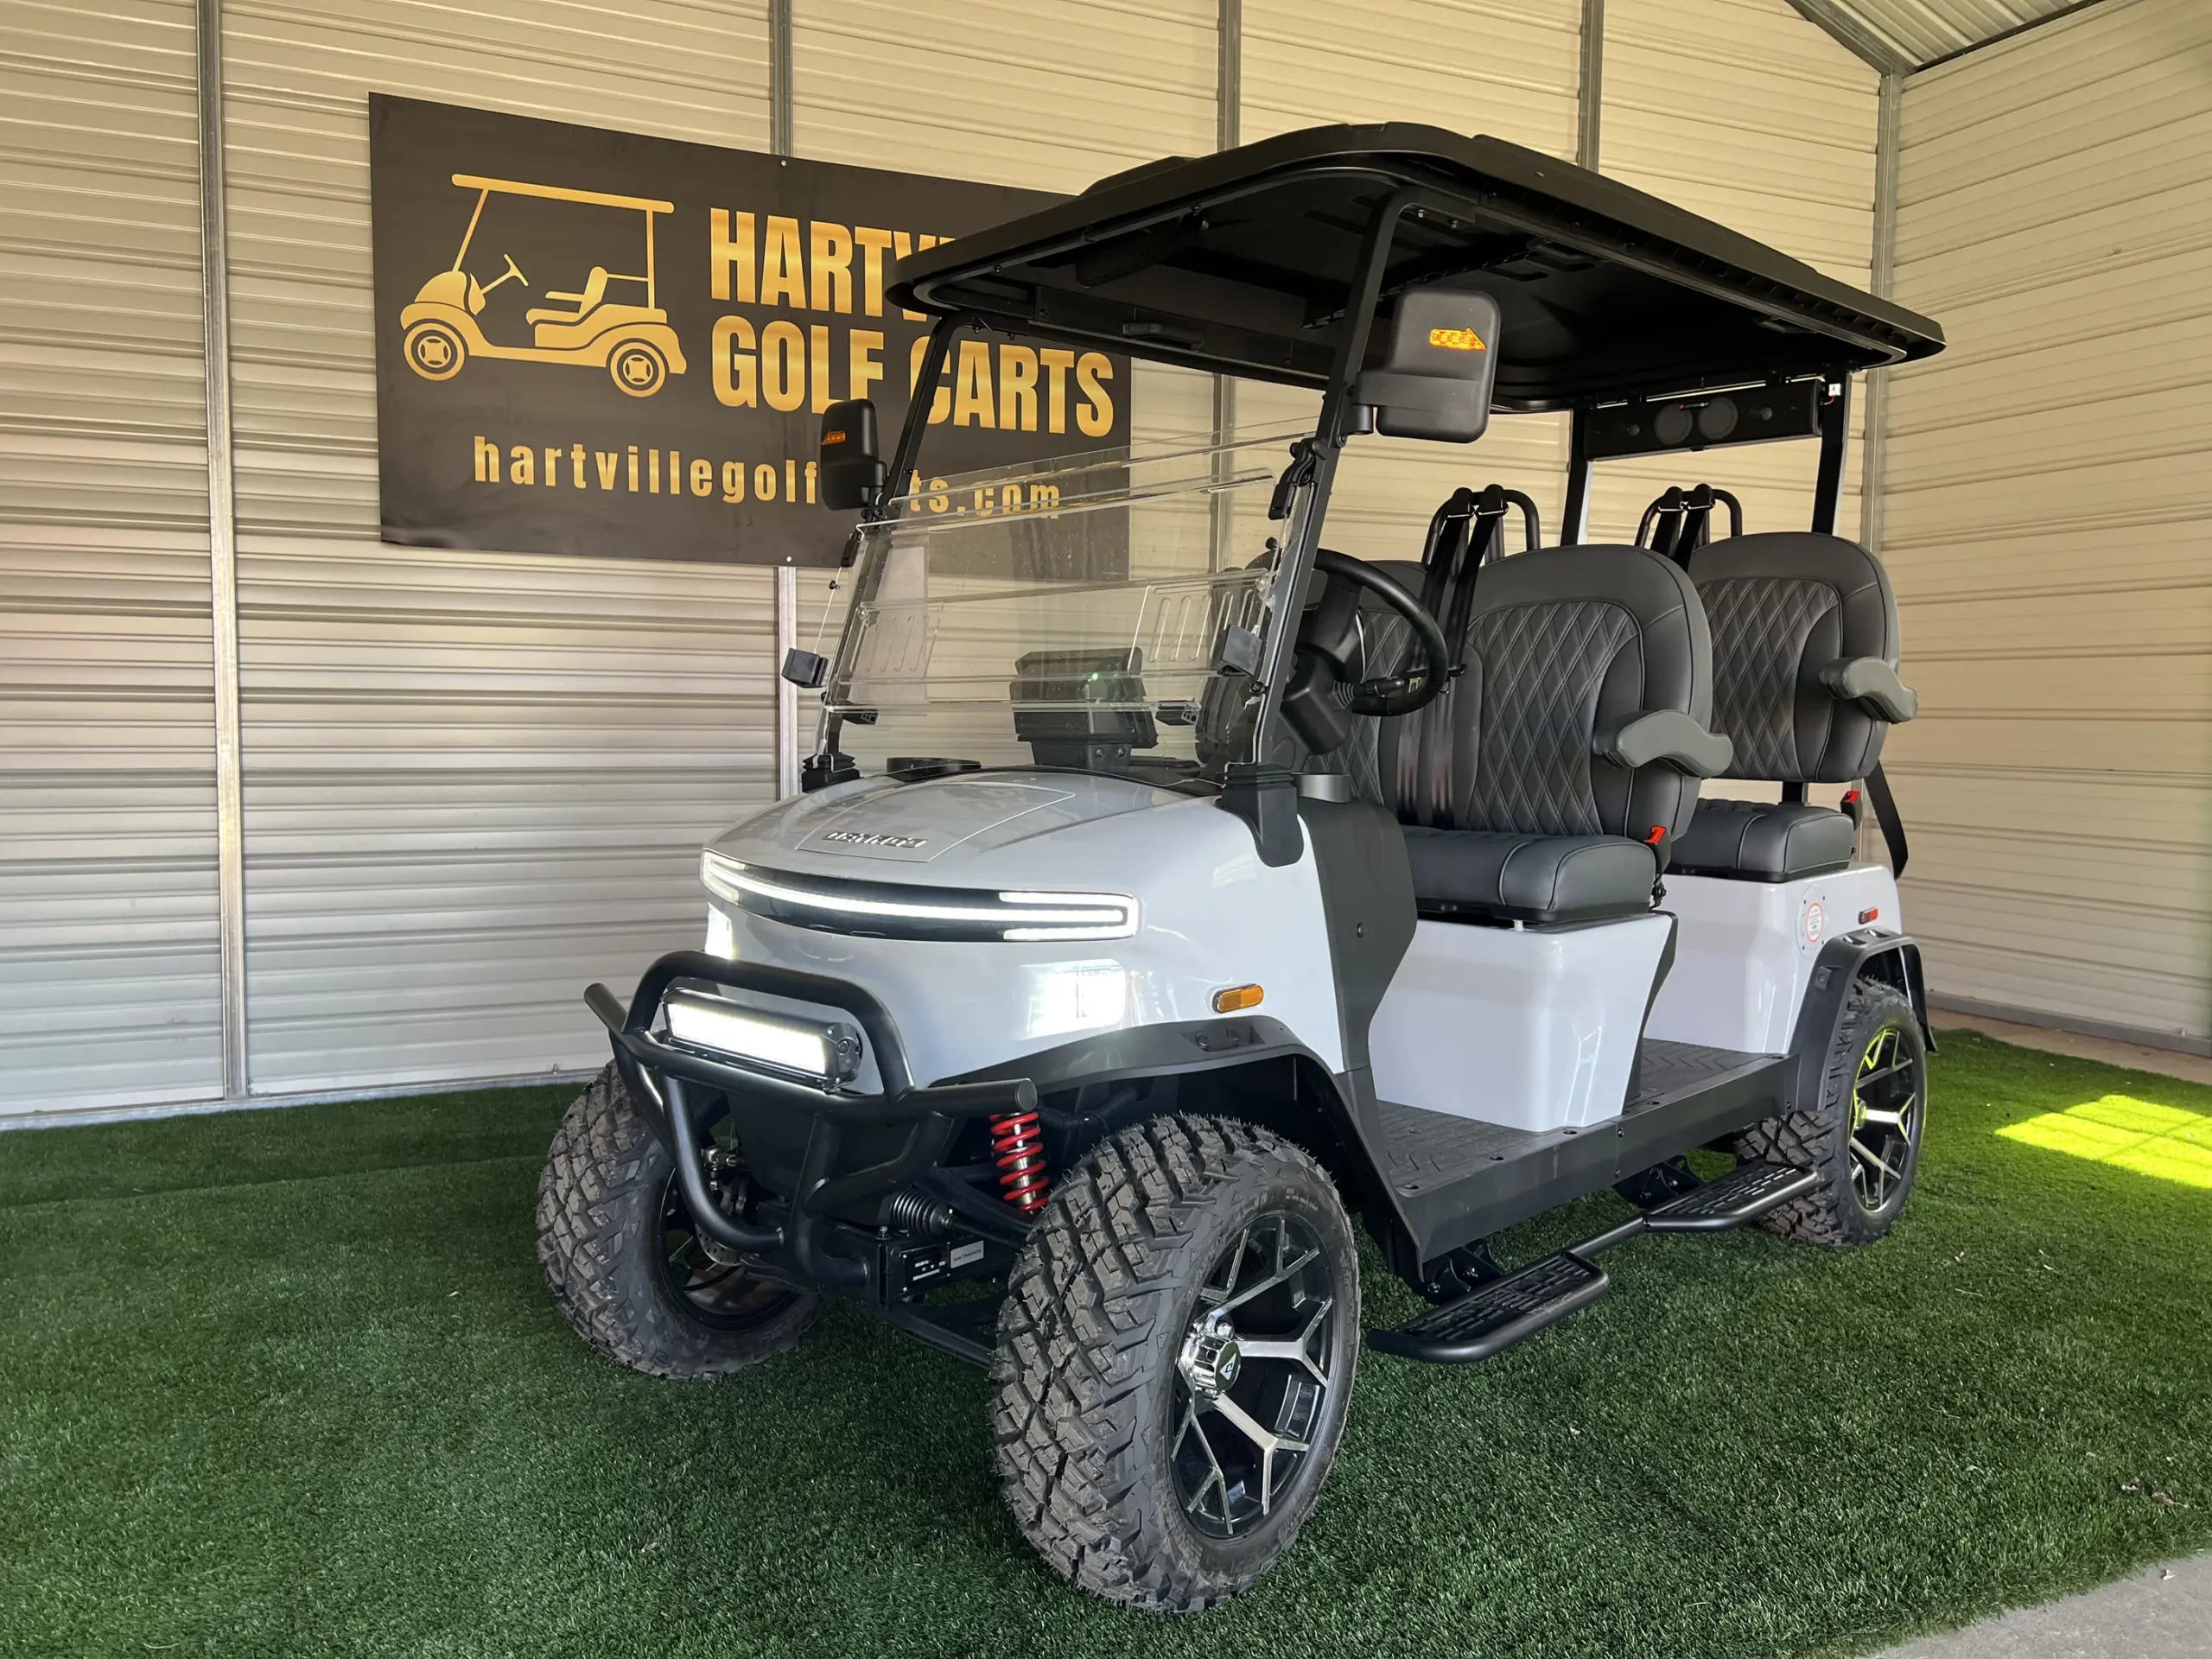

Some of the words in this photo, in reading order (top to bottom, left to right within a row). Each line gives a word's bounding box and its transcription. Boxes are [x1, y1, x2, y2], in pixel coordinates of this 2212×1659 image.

[710, 207, 956, 321] HART
[712, 315, 884, 414] GOLF
[910, 336, 1114, 437] CARTS
[474, 435, 1060, 519] hartvillegolfts.com
